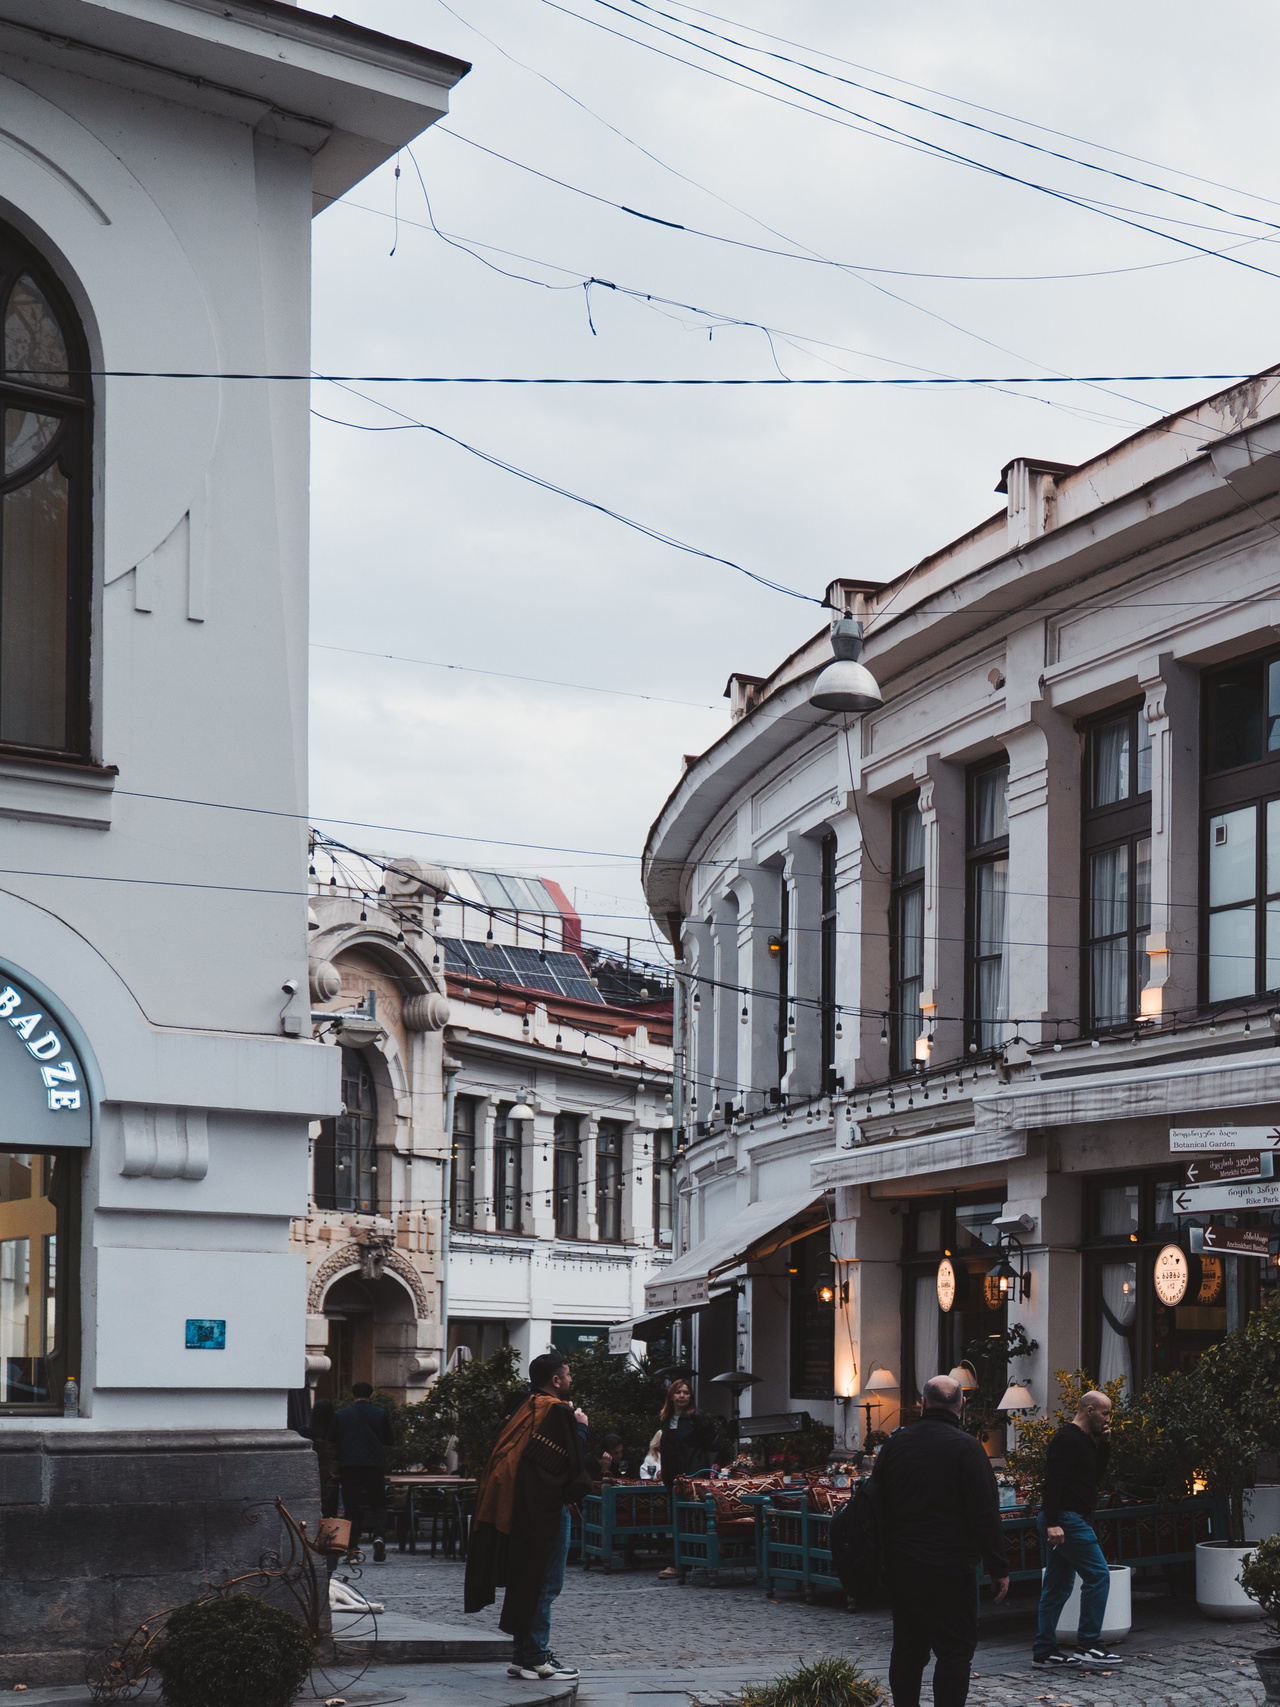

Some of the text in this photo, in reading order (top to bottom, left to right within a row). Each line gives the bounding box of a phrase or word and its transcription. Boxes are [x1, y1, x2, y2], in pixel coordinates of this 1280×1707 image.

[1219, 1129, 1237, 1137] ბაღი
[1220, 1166, 1259, 1177] Metekhi Church
[1228, 1186, 1279, 1197] რიყის პარკი
